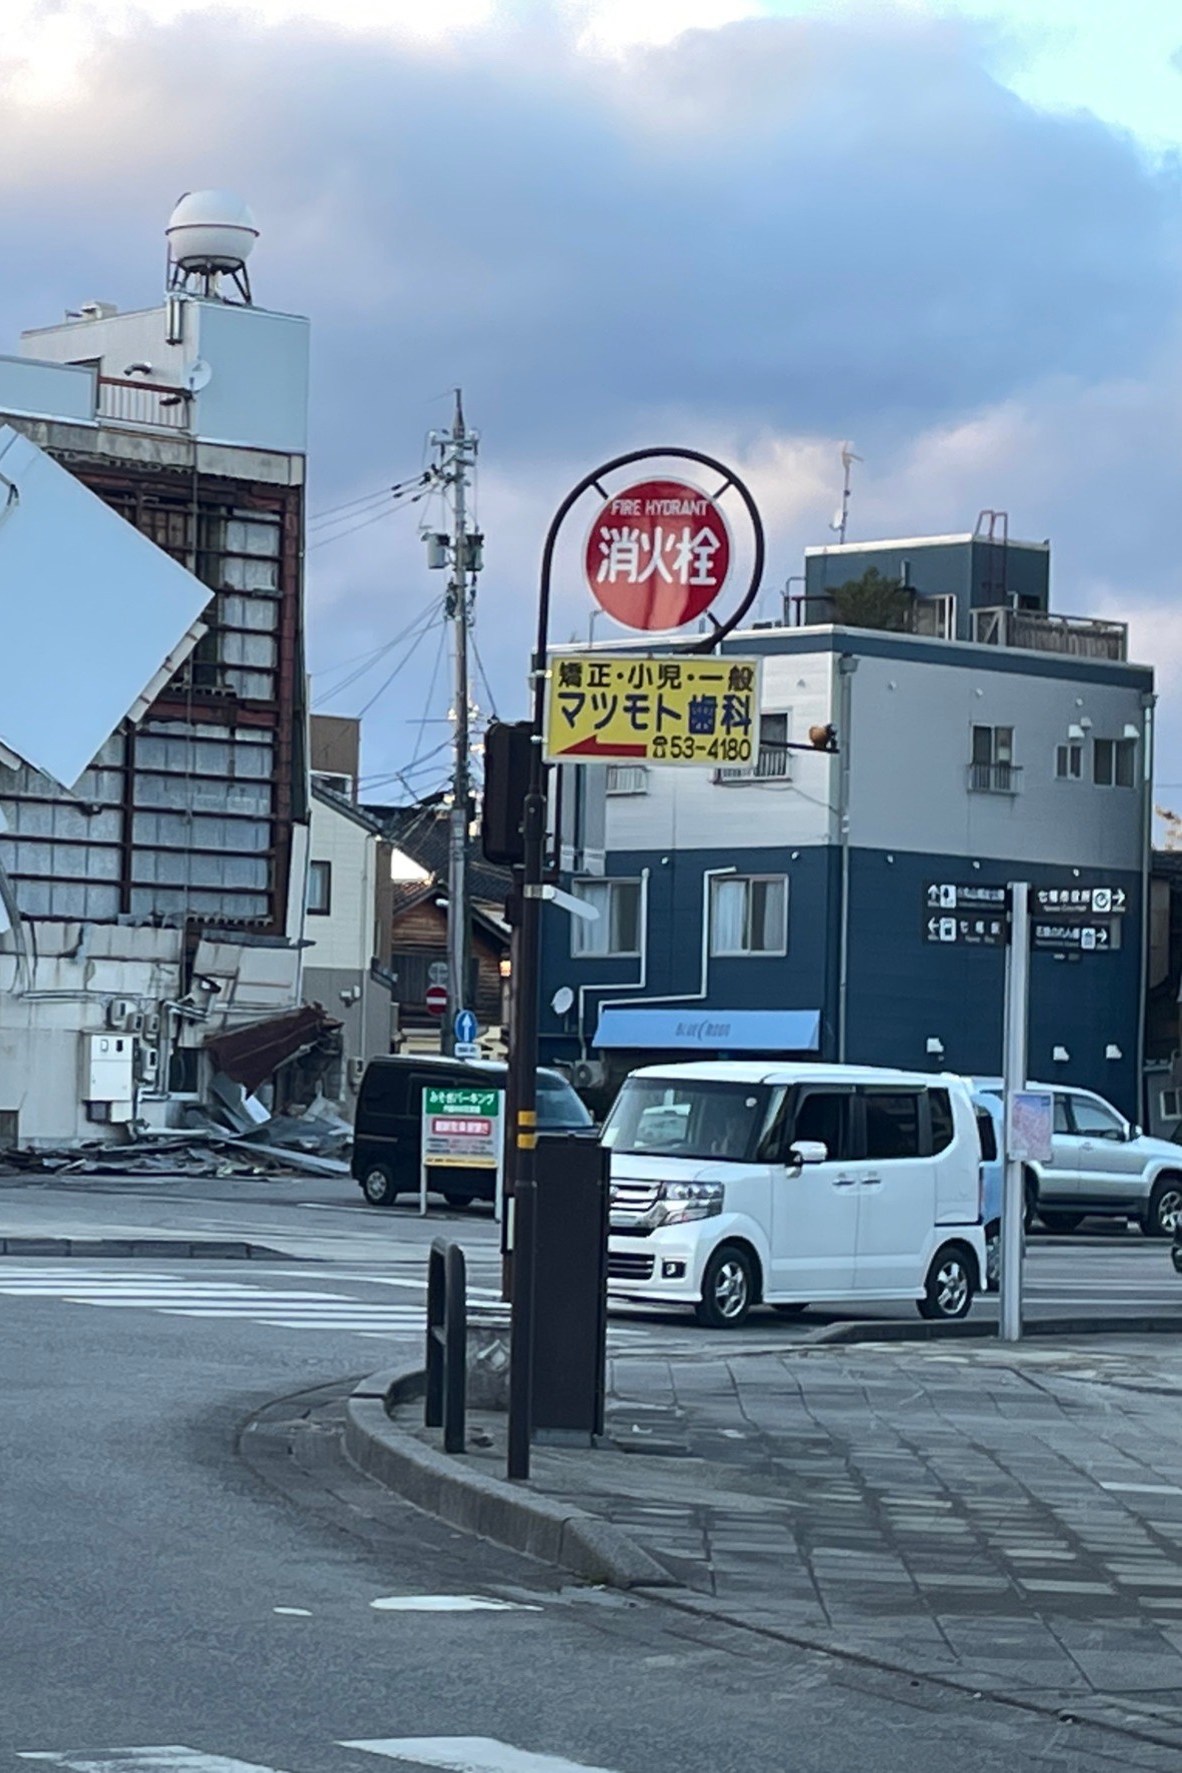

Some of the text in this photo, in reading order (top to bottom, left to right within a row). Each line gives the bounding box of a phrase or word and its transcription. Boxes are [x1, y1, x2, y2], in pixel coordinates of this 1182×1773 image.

[610, 499, 709, 516] FIRE HYDRANT
[597, 526, 721, 586] 消火栓
[558, 662, 754, 693] 矯正・小児・一般
[557, 692, 753, 736] マツモト歯科
[672, 735, 752, 762] 53-4180
